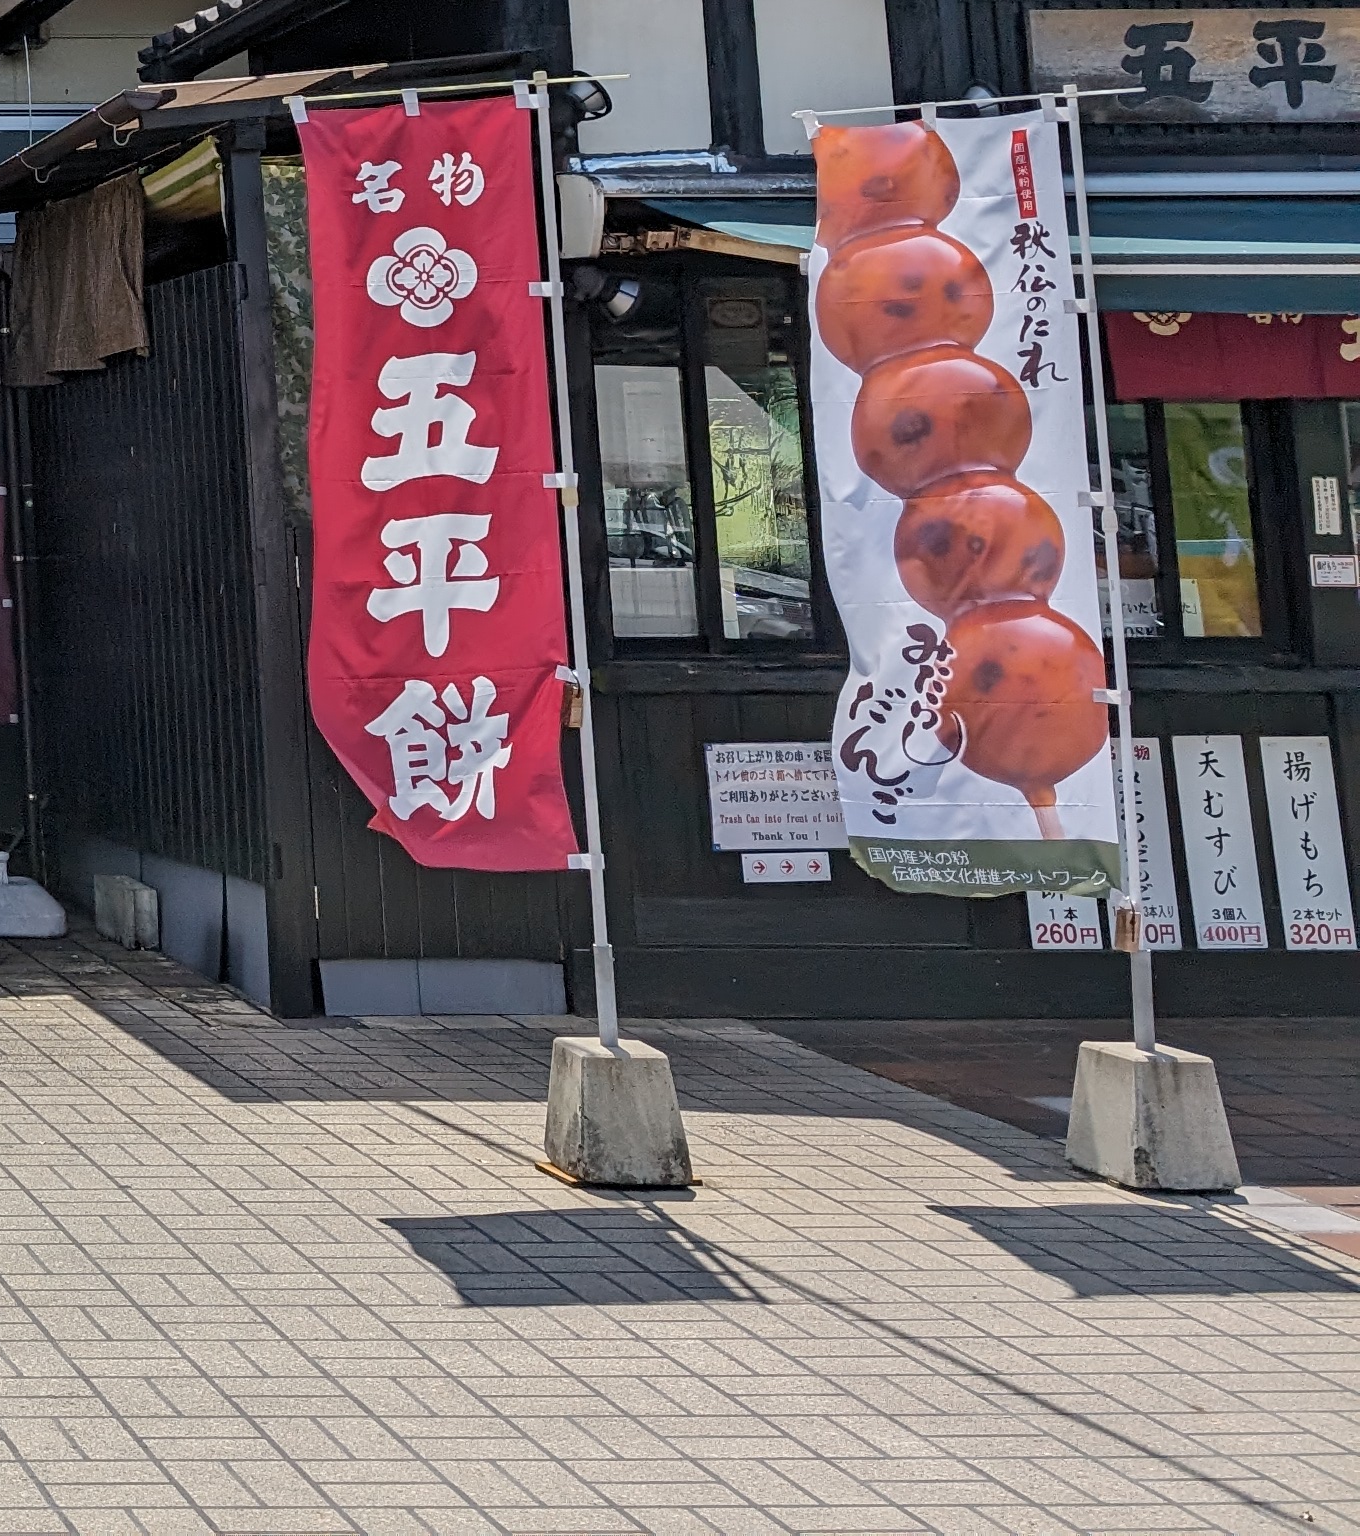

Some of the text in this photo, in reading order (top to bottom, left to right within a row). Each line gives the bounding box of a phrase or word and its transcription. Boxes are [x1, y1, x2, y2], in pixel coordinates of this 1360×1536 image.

[1117, 20, 1337, 110] 五平
[351, 151, 485, 214] 名物
[1014, 142, 1034, 212] 国産米粉使用
[361, 351, 516, 823] 五平餅
[903, 622, 964, 766] みたらし
[840, 679, 918, 827] だんご
[720, 815, 743, 824] Trash
[746, 815, 761, 824] Can
[765, 814, 782, 823] into
[813, 813, 821, 823] of
[1196, 748, 1238, 899] 天むすび
[1283, 750, 1325, 900] 揚げもち
[752, 832, 783, 841] Thank
[789, 832, 809, 841] You
[868, 847, 970, 866] 国内産米の粉
[892, 865, 1108, 886] 伝統食文化推進ネットワーク
[1212, 907, 1247, 921] 3個入
[1292, 907, 1343, 921] 2本セット
[1035, 923, 1098, 945] 260円
[1144, 923, 1176, 944] 0円
[1202, 925, 1262, 944] 400円
[1289, 923, 1353, 945] 320円
